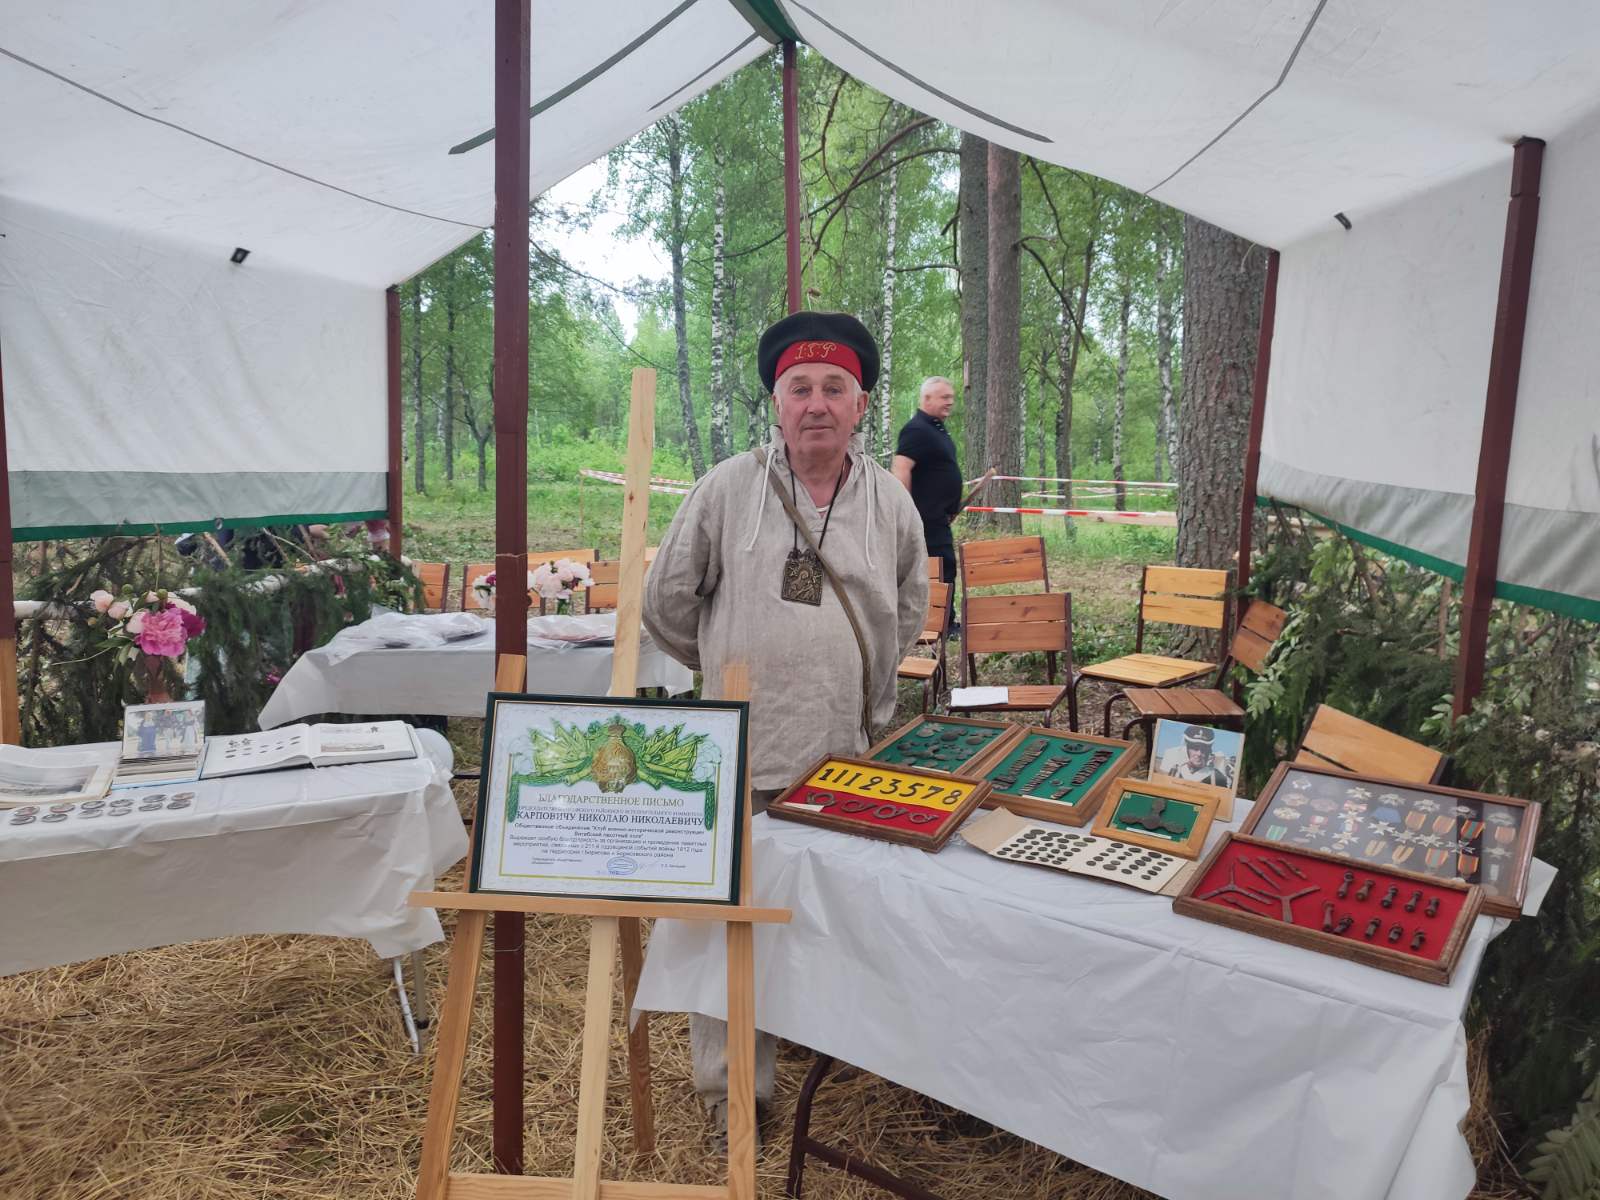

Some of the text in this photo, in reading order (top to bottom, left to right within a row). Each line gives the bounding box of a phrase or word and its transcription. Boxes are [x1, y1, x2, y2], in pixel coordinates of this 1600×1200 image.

[642, 797, 684, 807] ПИСЬМО
[516, 811, 704, 826] КАРПОВИЧУ НИКОЛАЮ НИКОЛАЕВИЧУ
